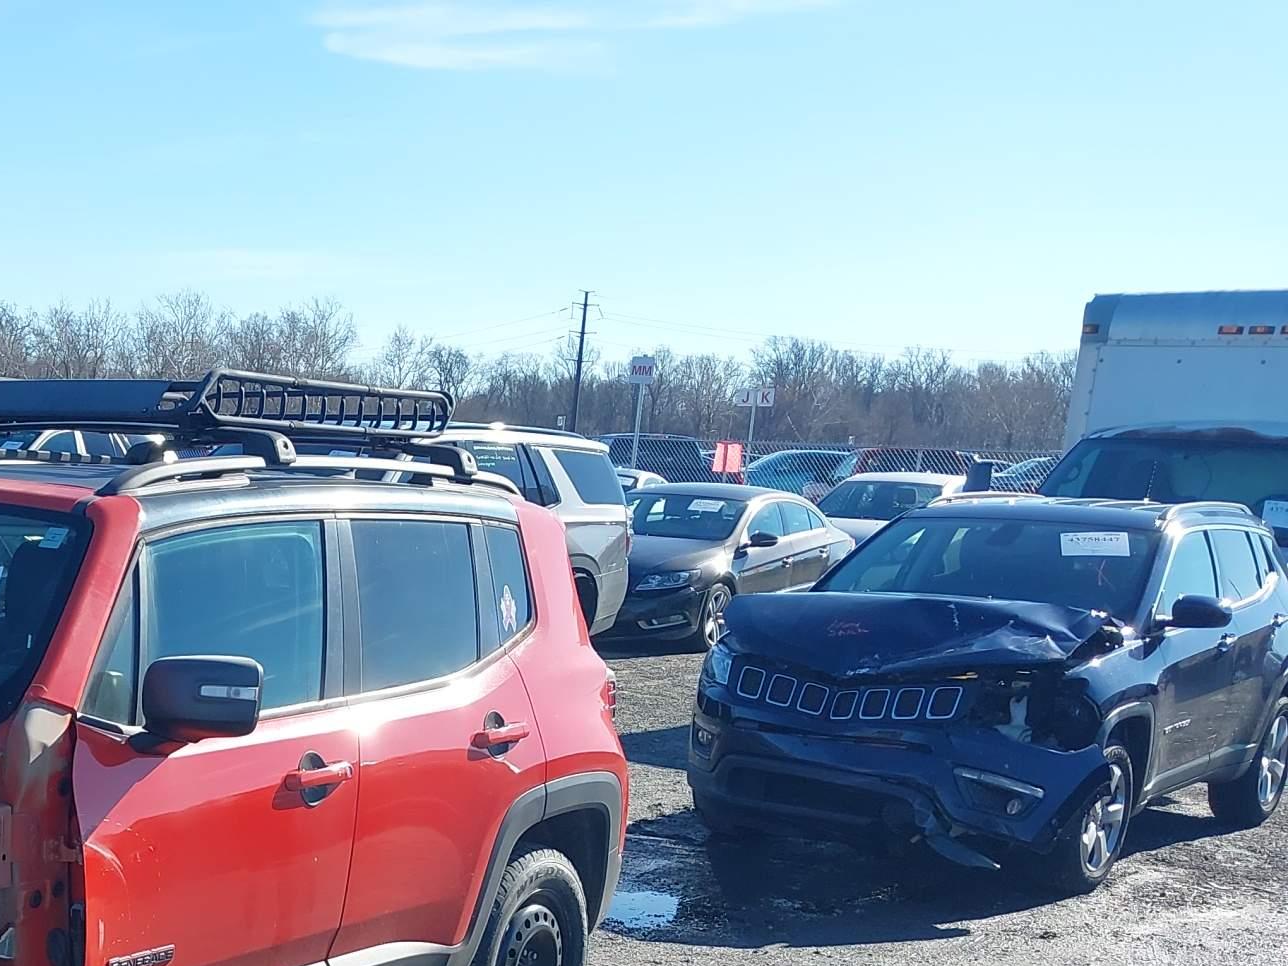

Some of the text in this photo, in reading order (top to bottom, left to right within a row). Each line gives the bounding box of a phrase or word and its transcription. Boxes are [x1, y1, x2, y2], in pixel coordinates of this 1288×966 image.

[631, 365, 653, 376] MM
[742, 391, 770, 403] J K
